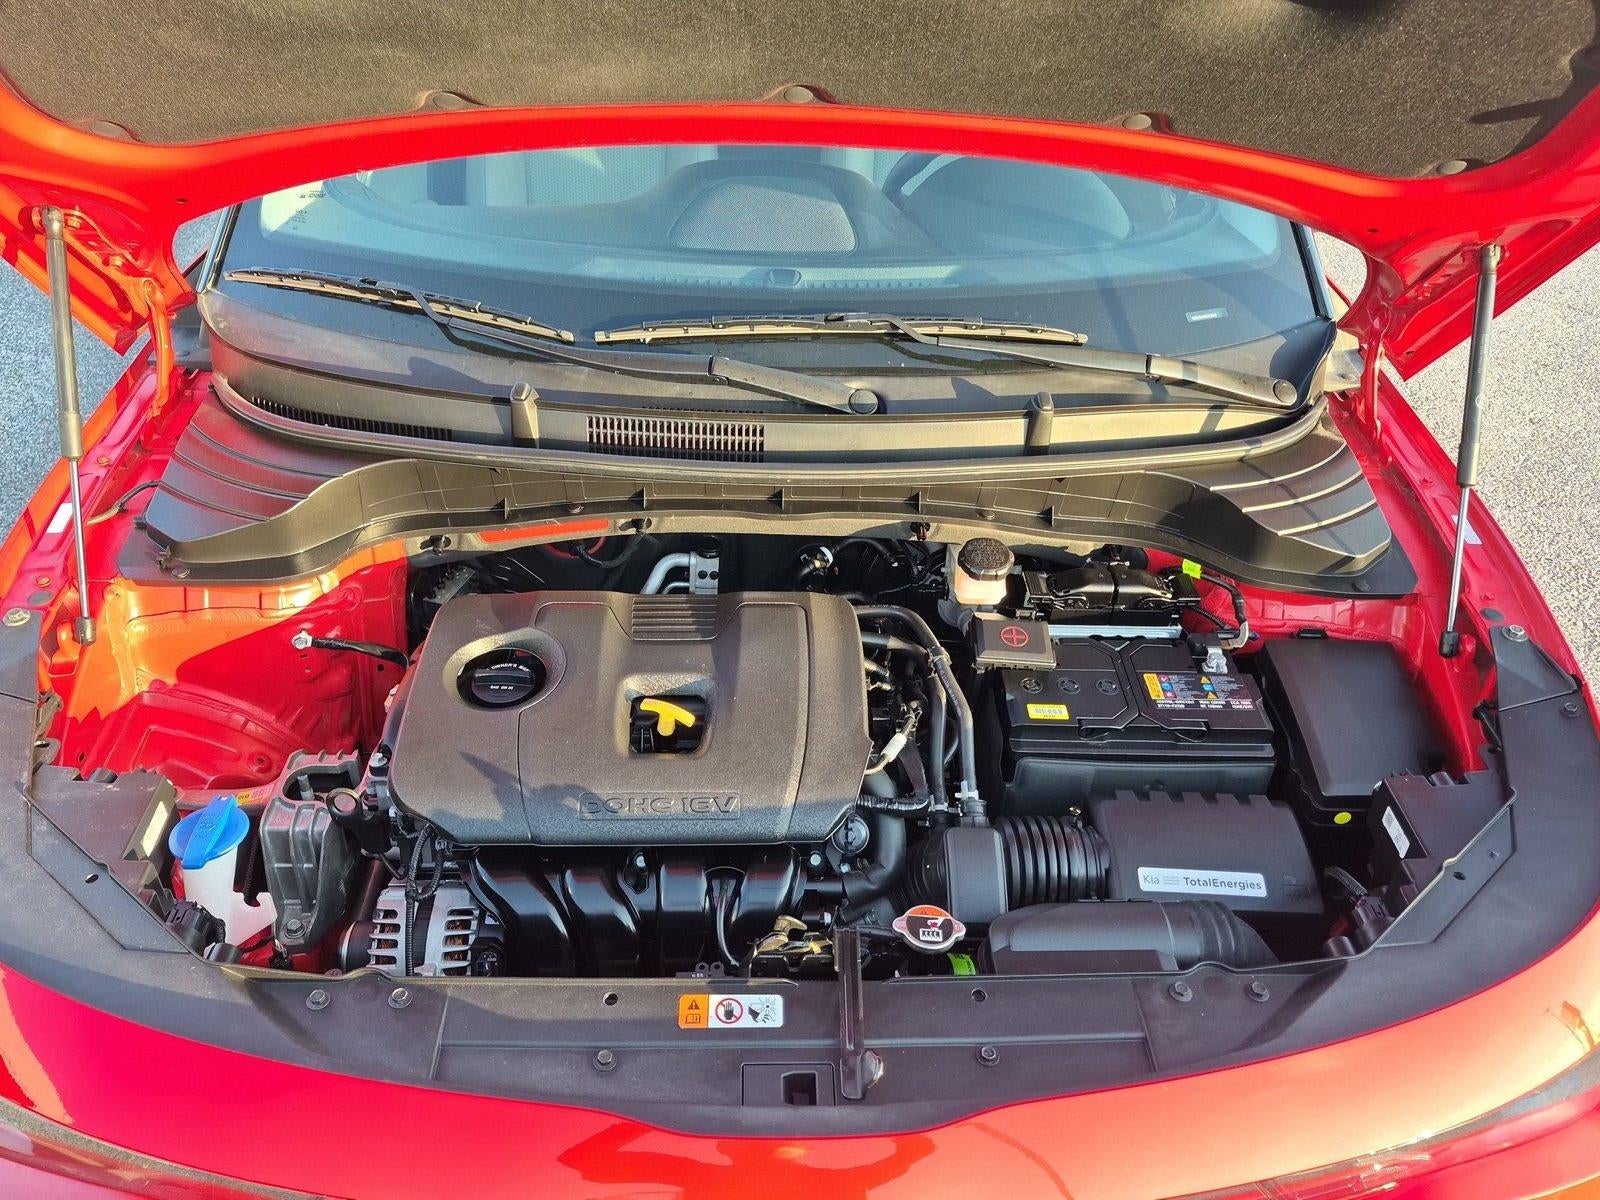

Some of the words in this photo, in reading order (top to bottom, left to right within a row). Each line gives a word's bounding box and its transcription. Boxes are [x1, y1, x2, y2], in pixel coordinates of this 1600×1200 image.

[580, 797, 675, 814] DOHC
[682, 797, 738, 814] 16V
[1143, 874, 1160, 885] Kia
[1182, 876, 1262, 891] TotalEnergies
